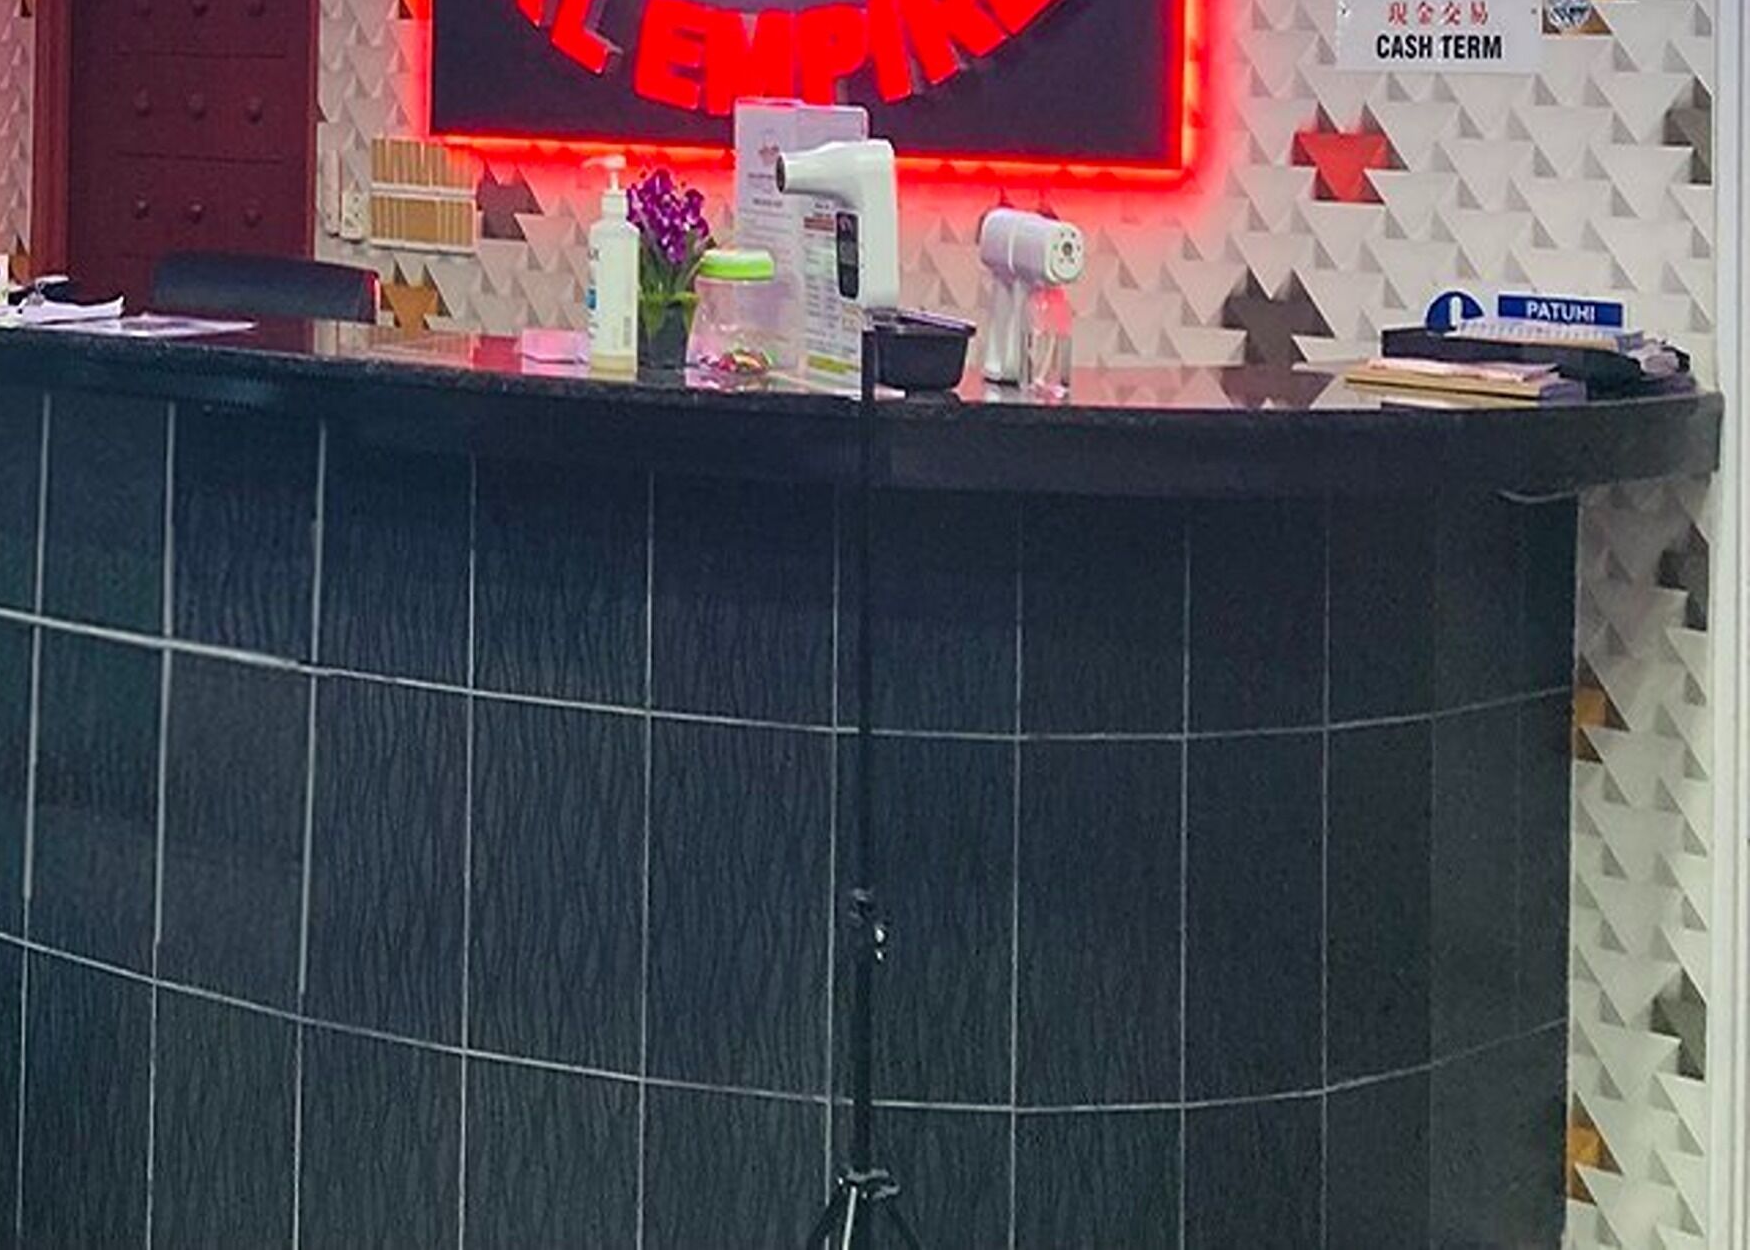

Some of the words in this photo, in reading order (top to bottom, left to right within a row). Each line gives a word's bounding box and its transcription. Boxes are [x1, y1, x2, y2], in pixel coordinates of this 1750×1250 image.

[1388, 1, 1489, 26] 現金交易
[1376, 34, 1432, 59] CASH
[1441, 35, 1503, 59] TERM
[1525, 300, 1596, 322] PATUHI
